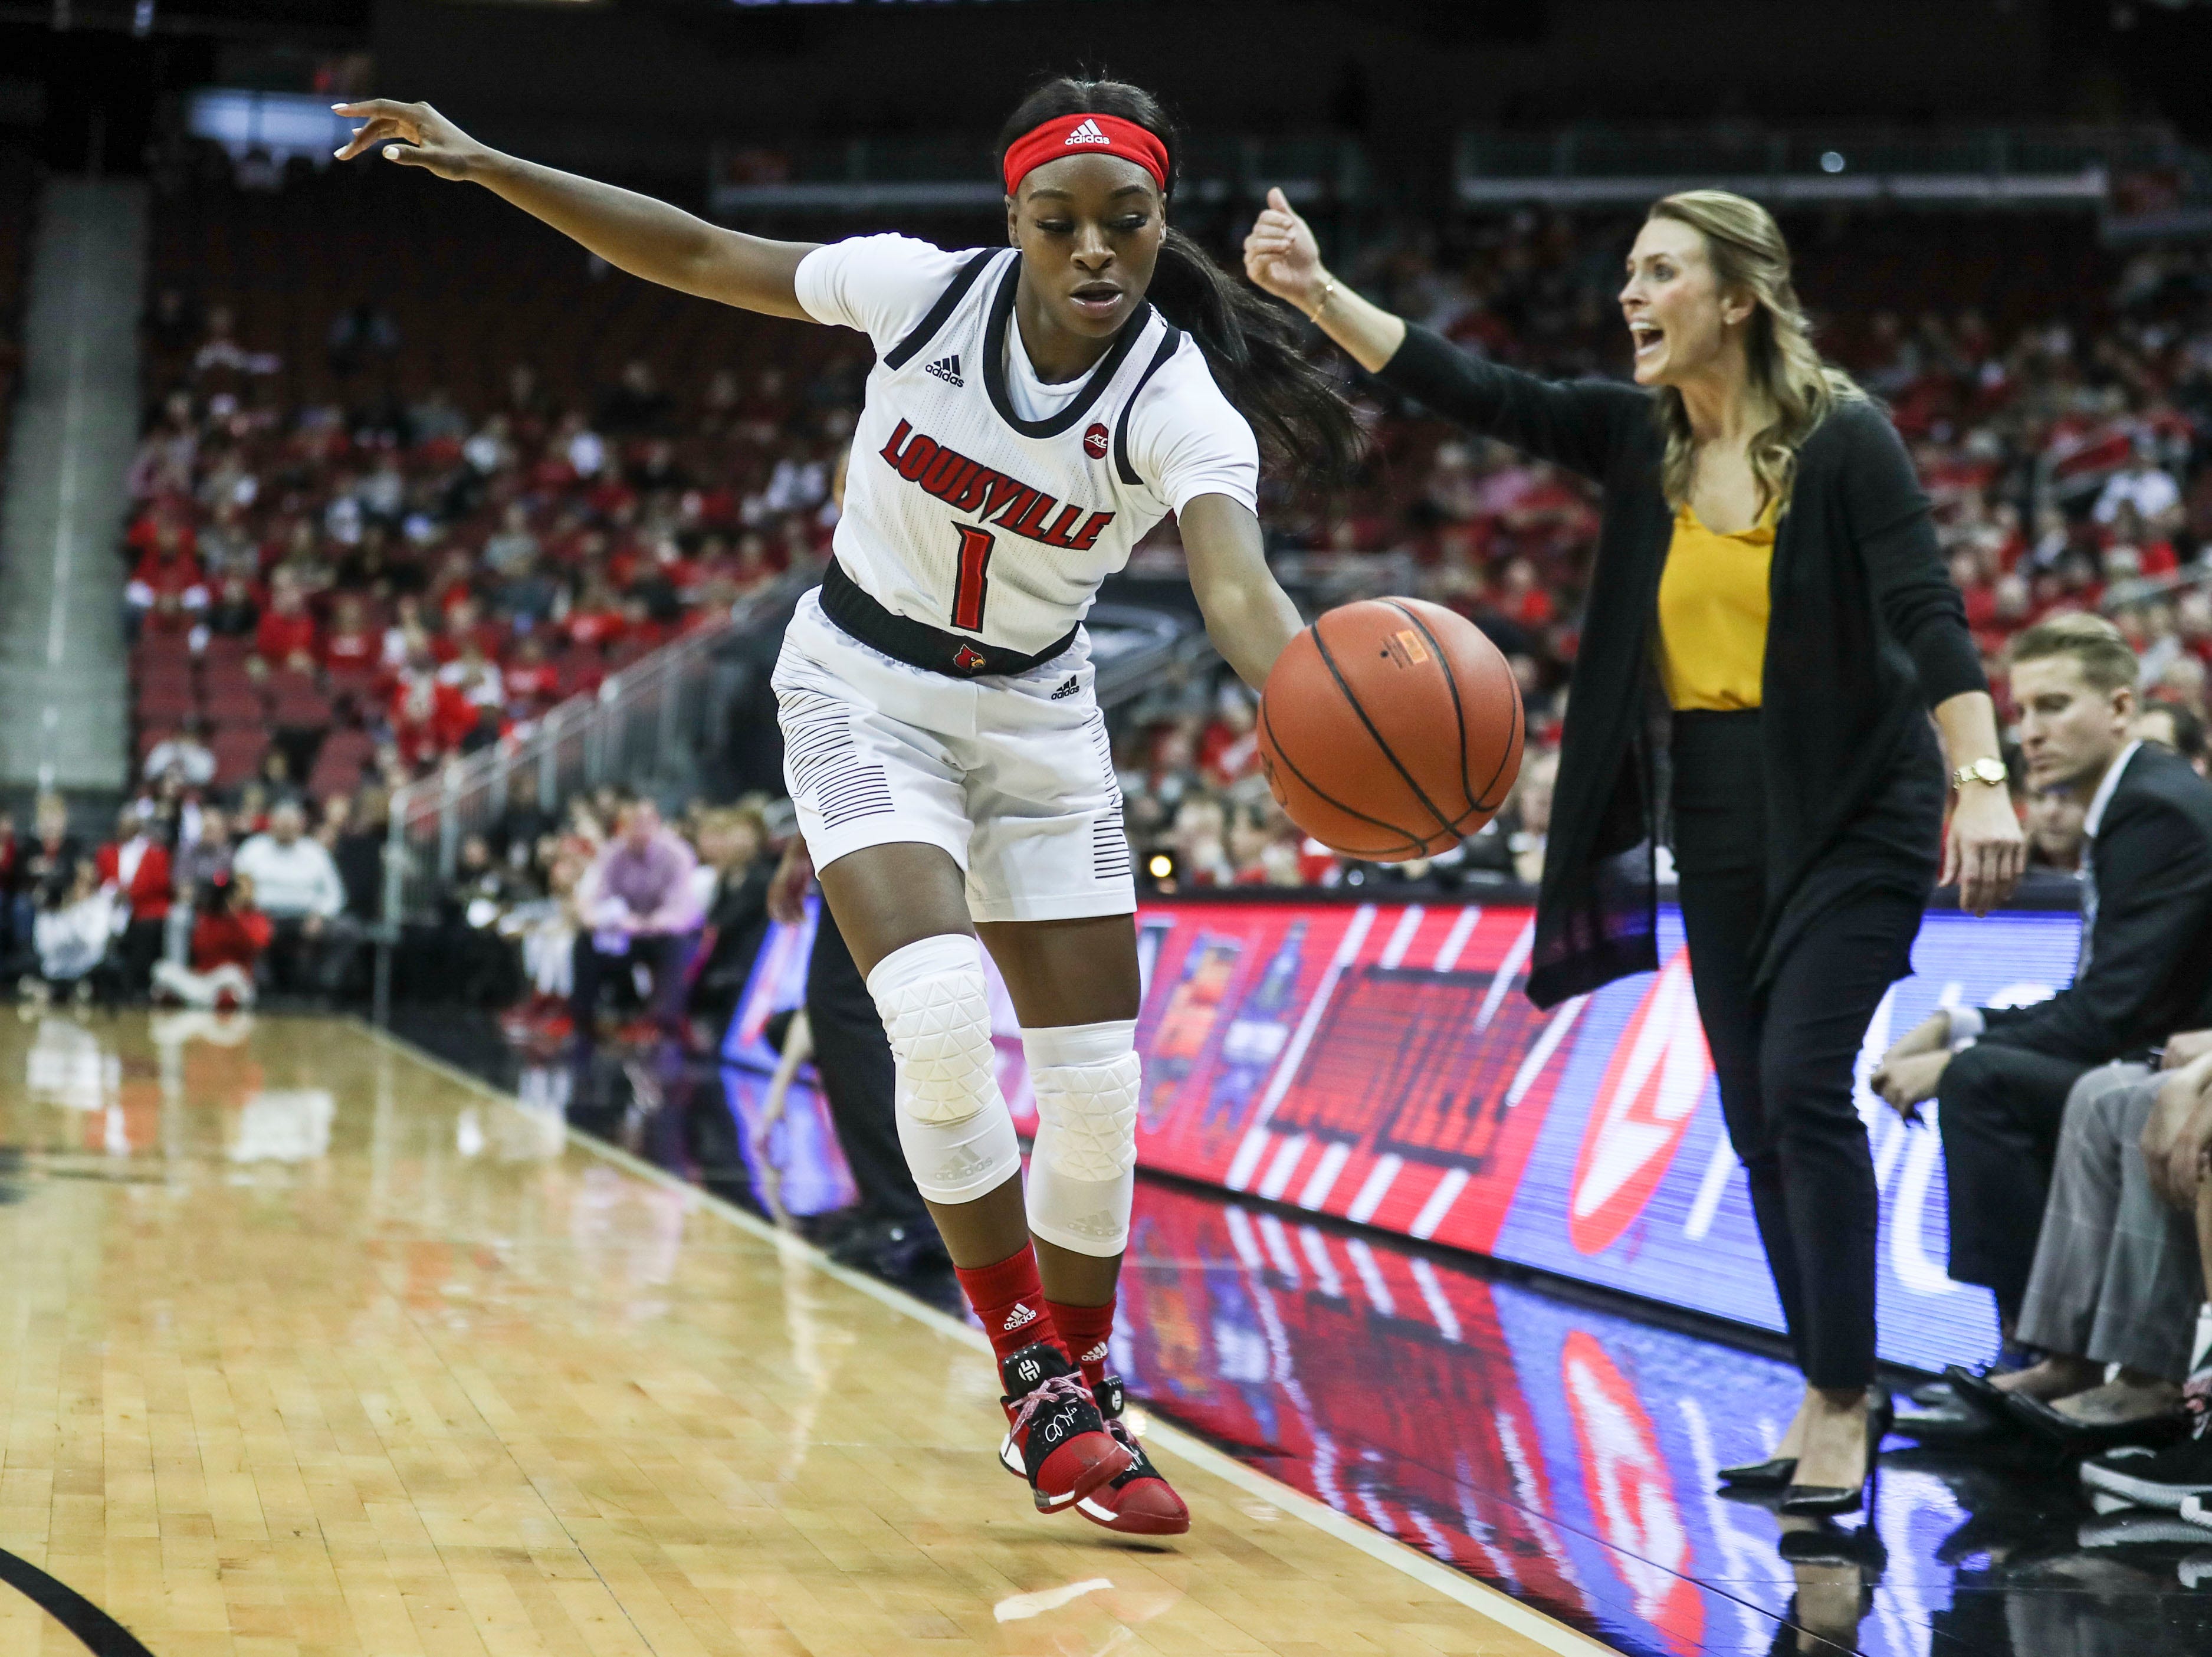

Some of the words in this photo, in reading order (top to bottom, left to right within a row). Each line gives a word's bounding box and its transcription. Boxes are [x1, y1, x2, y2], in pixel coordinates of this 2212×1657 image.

[1065, 134, 1110, 145] adidas
[926, 364, 964, 388] adidas
[1086, 434, 1108, 447] ACC
[879, 418, 1116, 550] LOUISVILLE
[950, 520, 996, 634] 1
[1051, 685, 1079, 700] adidas
[935, 1157, 993, 1181] adidas
[1004, 1310, 1036, 1330] adidas
